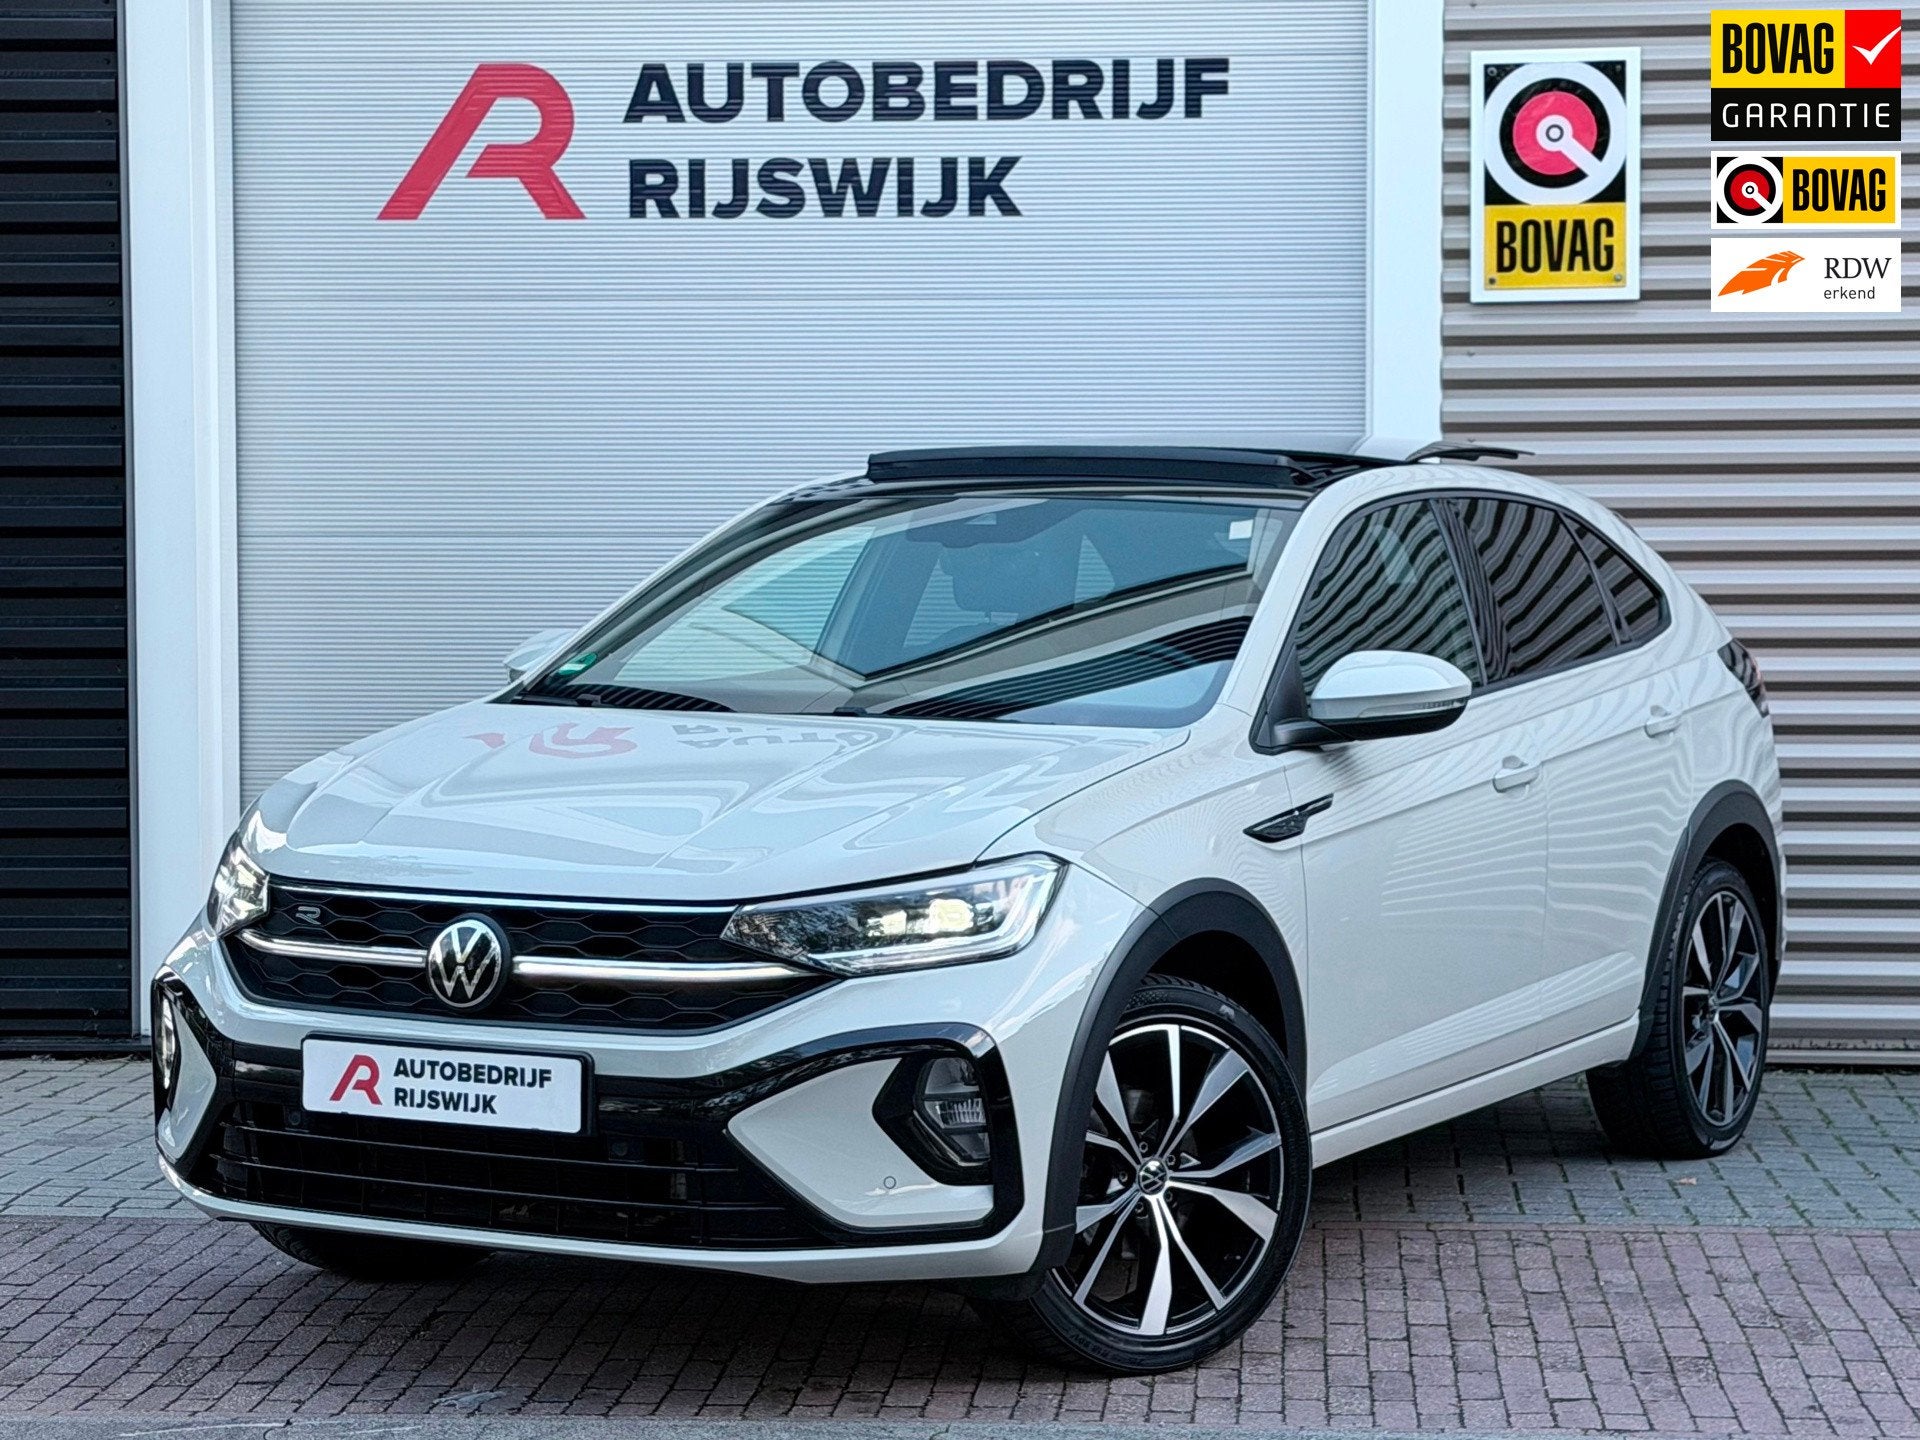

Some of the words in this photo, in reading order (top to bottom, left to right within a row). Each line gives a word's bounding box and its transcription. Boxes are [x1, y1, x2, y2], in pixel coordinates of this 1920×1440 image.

[622, 57, 1230, 124] AUTOBEDRIJF
[628, 155, 1024, 220] RIJSWIJK
[1495, 217, 1615, 273] BOVAG
[393, 1058, 552, 1088] AUTOBEDRIJF
[394, 1087, 497, 1114] RIJSWIJK
